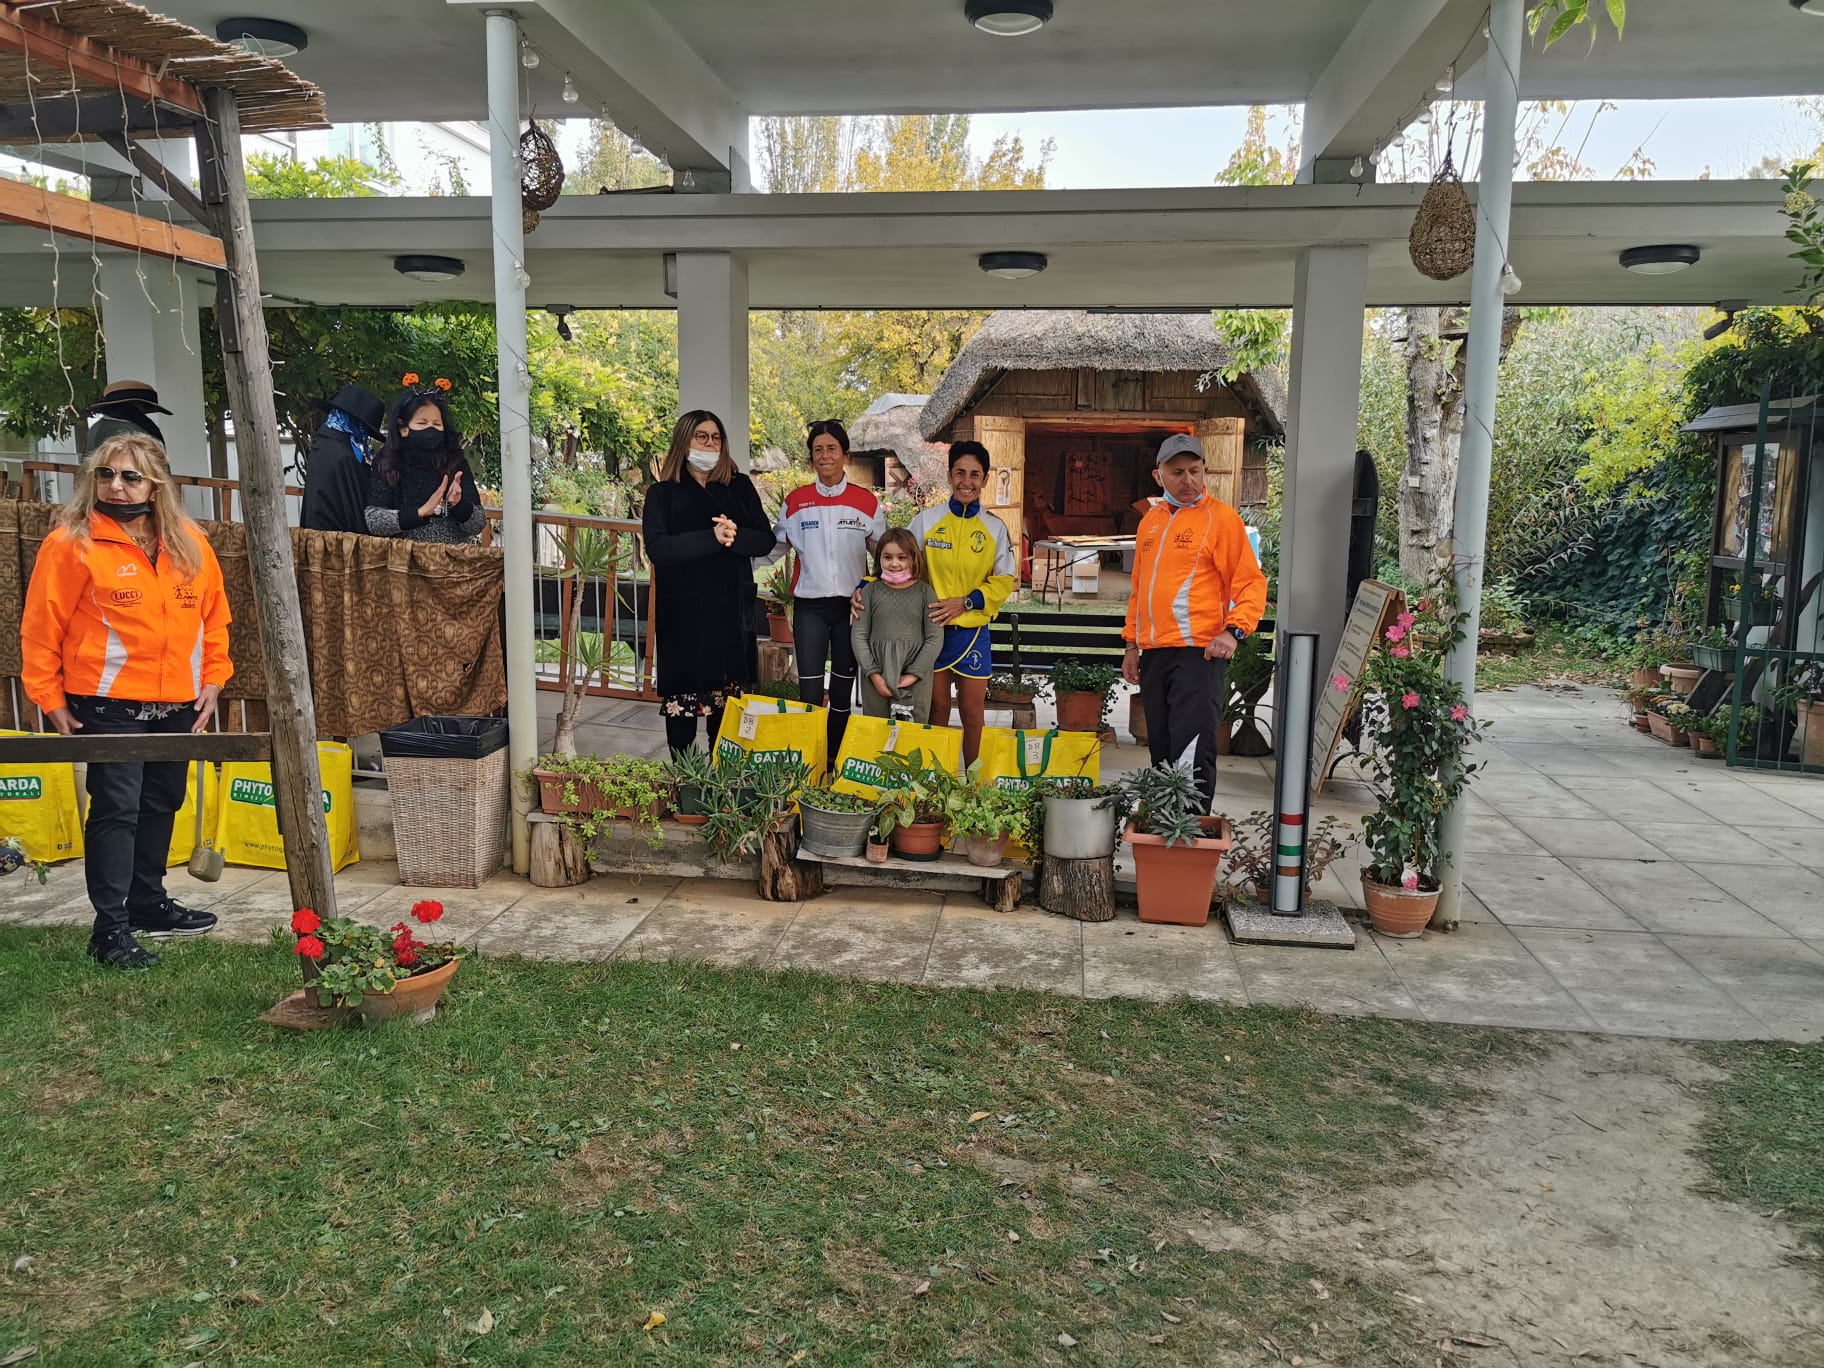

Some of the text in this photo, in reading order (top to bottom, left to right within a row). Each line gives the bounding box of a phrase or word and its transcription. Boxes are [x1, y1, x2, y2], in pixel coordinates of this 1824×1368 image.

[114, 590, 138, 600] LUCCI
[846, 758, 882, 778] PHYTO
[234, 779, 272, 796] PHYTO
